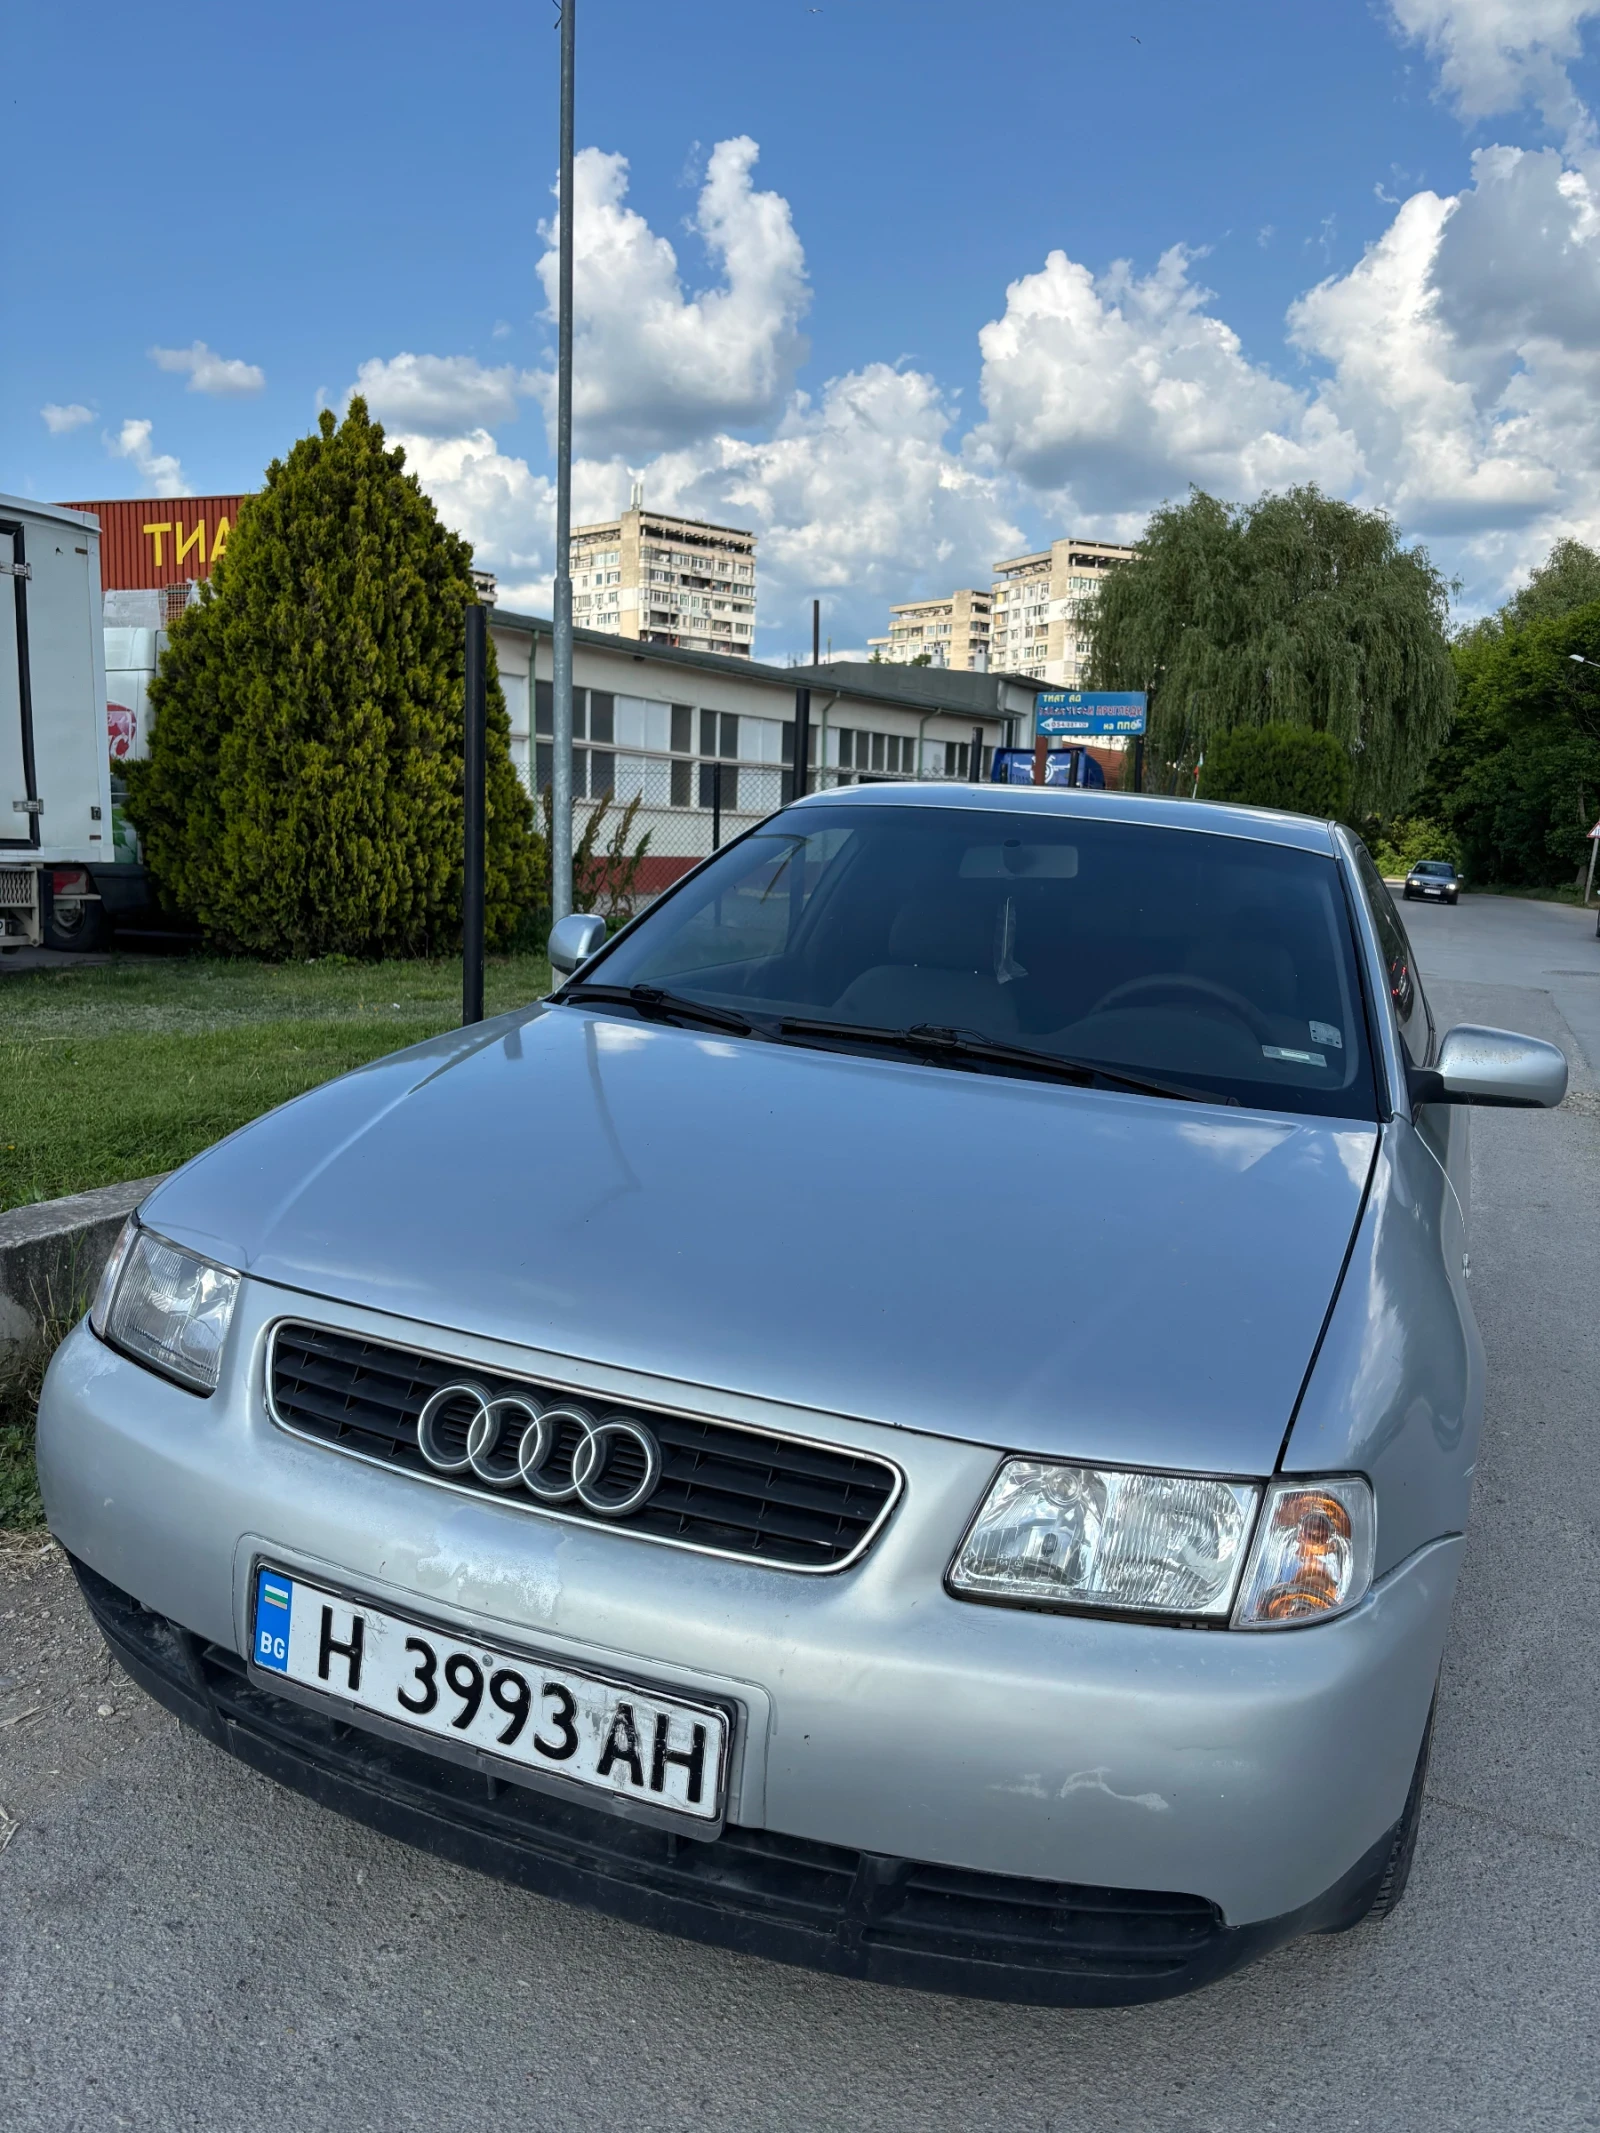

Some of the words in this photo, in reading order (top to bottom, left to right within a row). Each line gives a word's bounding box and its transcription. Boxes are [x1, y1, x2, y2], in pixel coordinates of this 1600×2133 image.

[1043, 694, 1065, 703] ТИАТ
[260, 1631, 286, 1659] BG
[318, 1604, 364, 1691] H
[397, 1636, 579, 1761] 3993
[596, 1701, 707, 1803] AH
